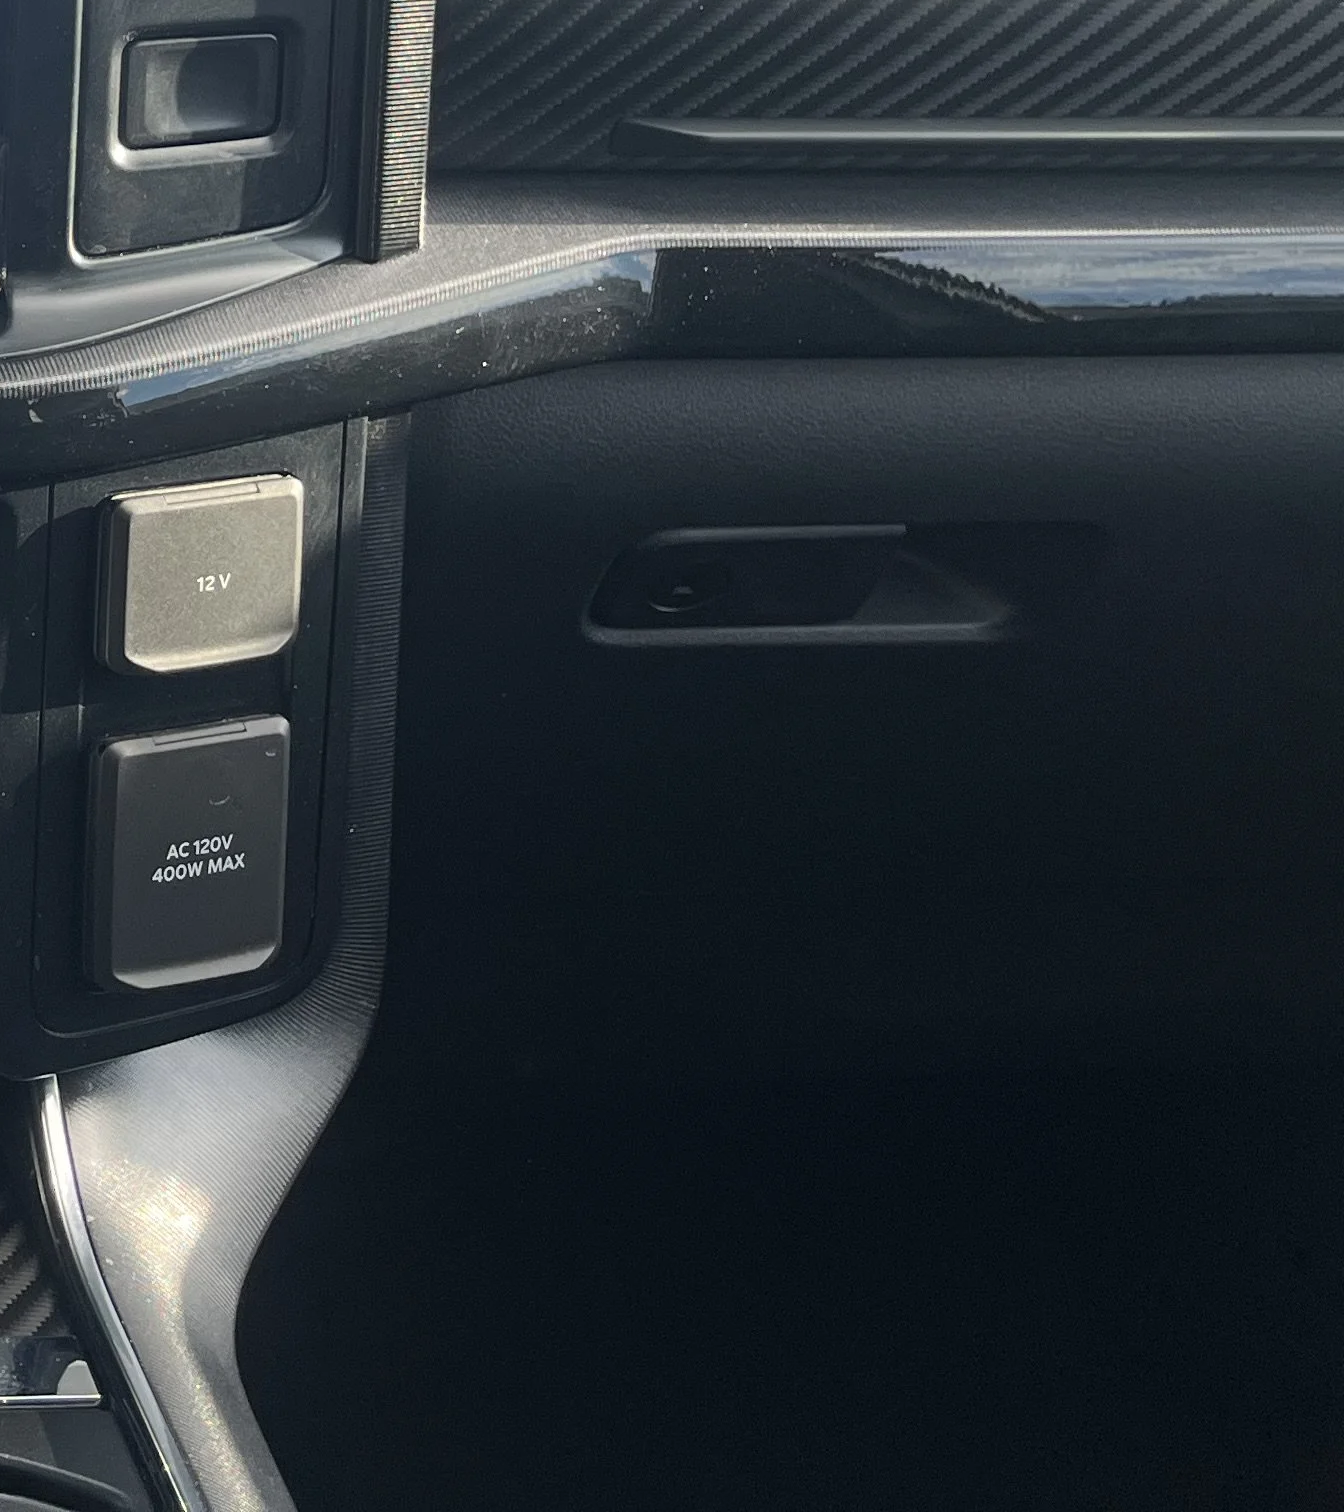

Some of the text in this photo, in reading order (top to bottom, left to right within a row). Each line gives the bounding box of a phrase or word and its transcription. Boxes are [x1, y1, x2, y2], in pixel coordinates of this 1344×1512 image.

[196, 572, 232, 593] 12 V
[166, 834, 235, 861] AC 120V
[151, 853, 247, 884] 400W MAX
